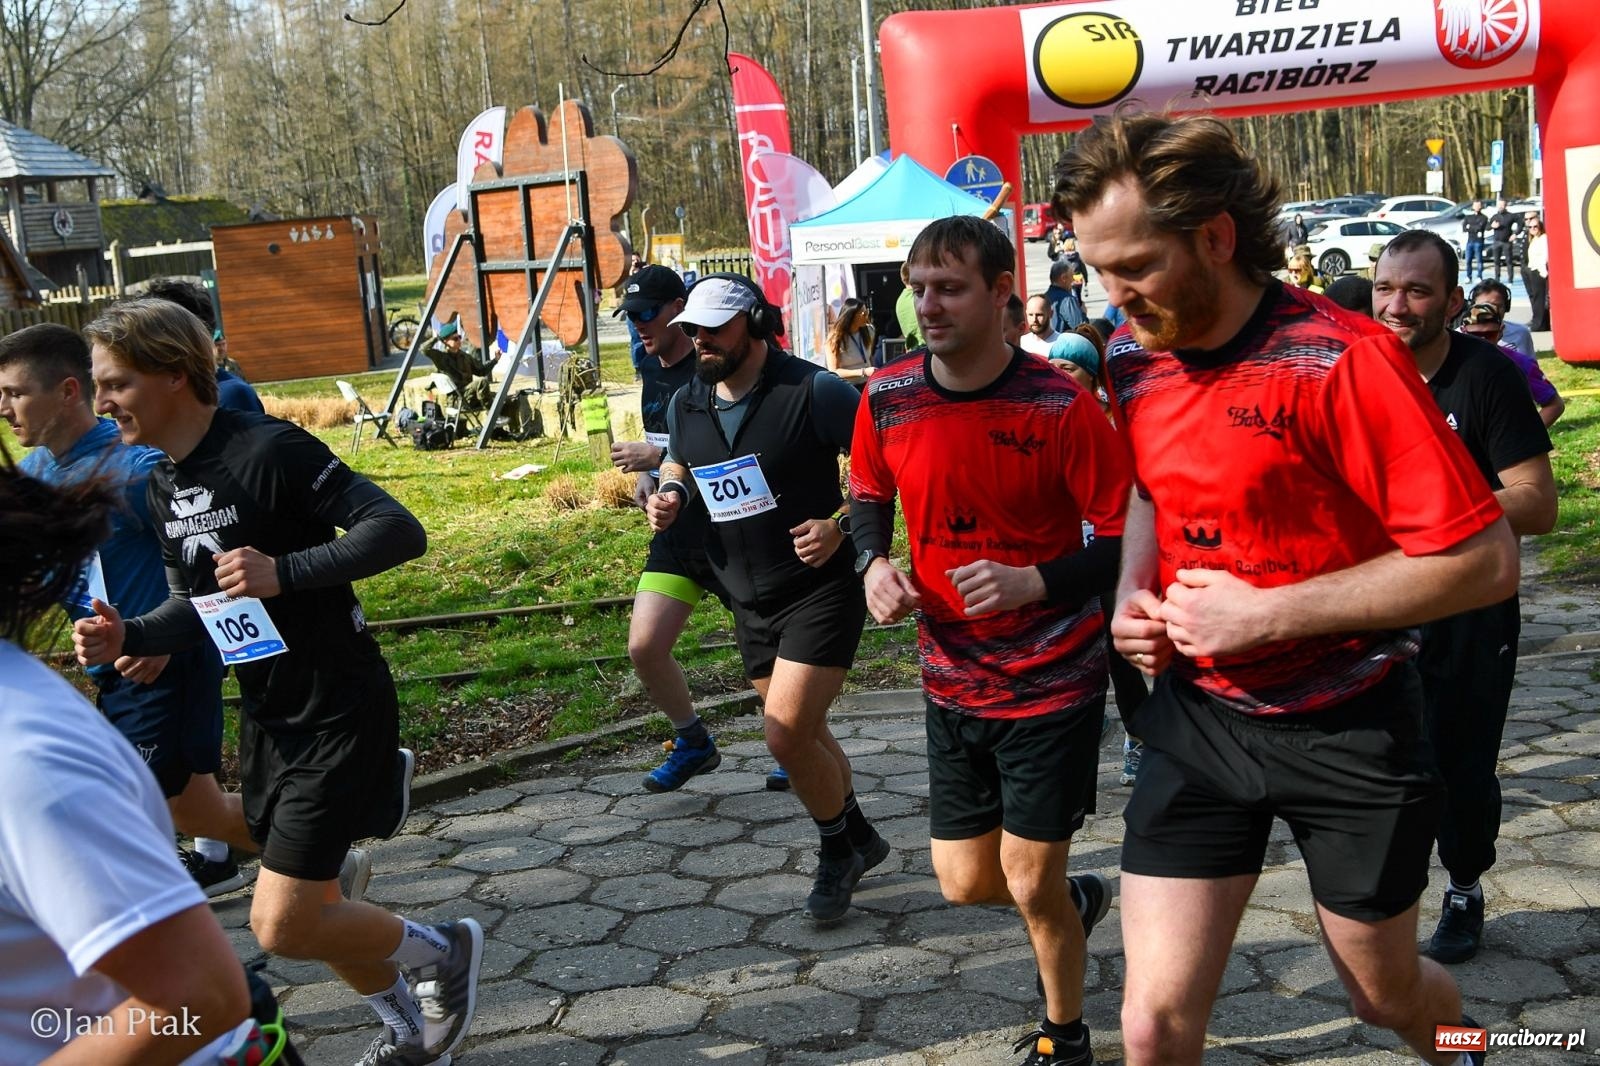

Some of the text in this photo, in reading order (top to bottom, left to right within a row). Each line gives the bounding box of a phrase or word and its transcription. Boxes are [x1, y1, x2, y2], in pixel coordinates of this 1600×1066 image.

[1167, 17, 1401, 62] TWARDZIELA
[1191, 58, 1377, 98] RACIBÓRZ
[1113, 342, 1144, 356] COL
[708, 475, 752, 502] 102
[216, 613, 259, 644] 106
